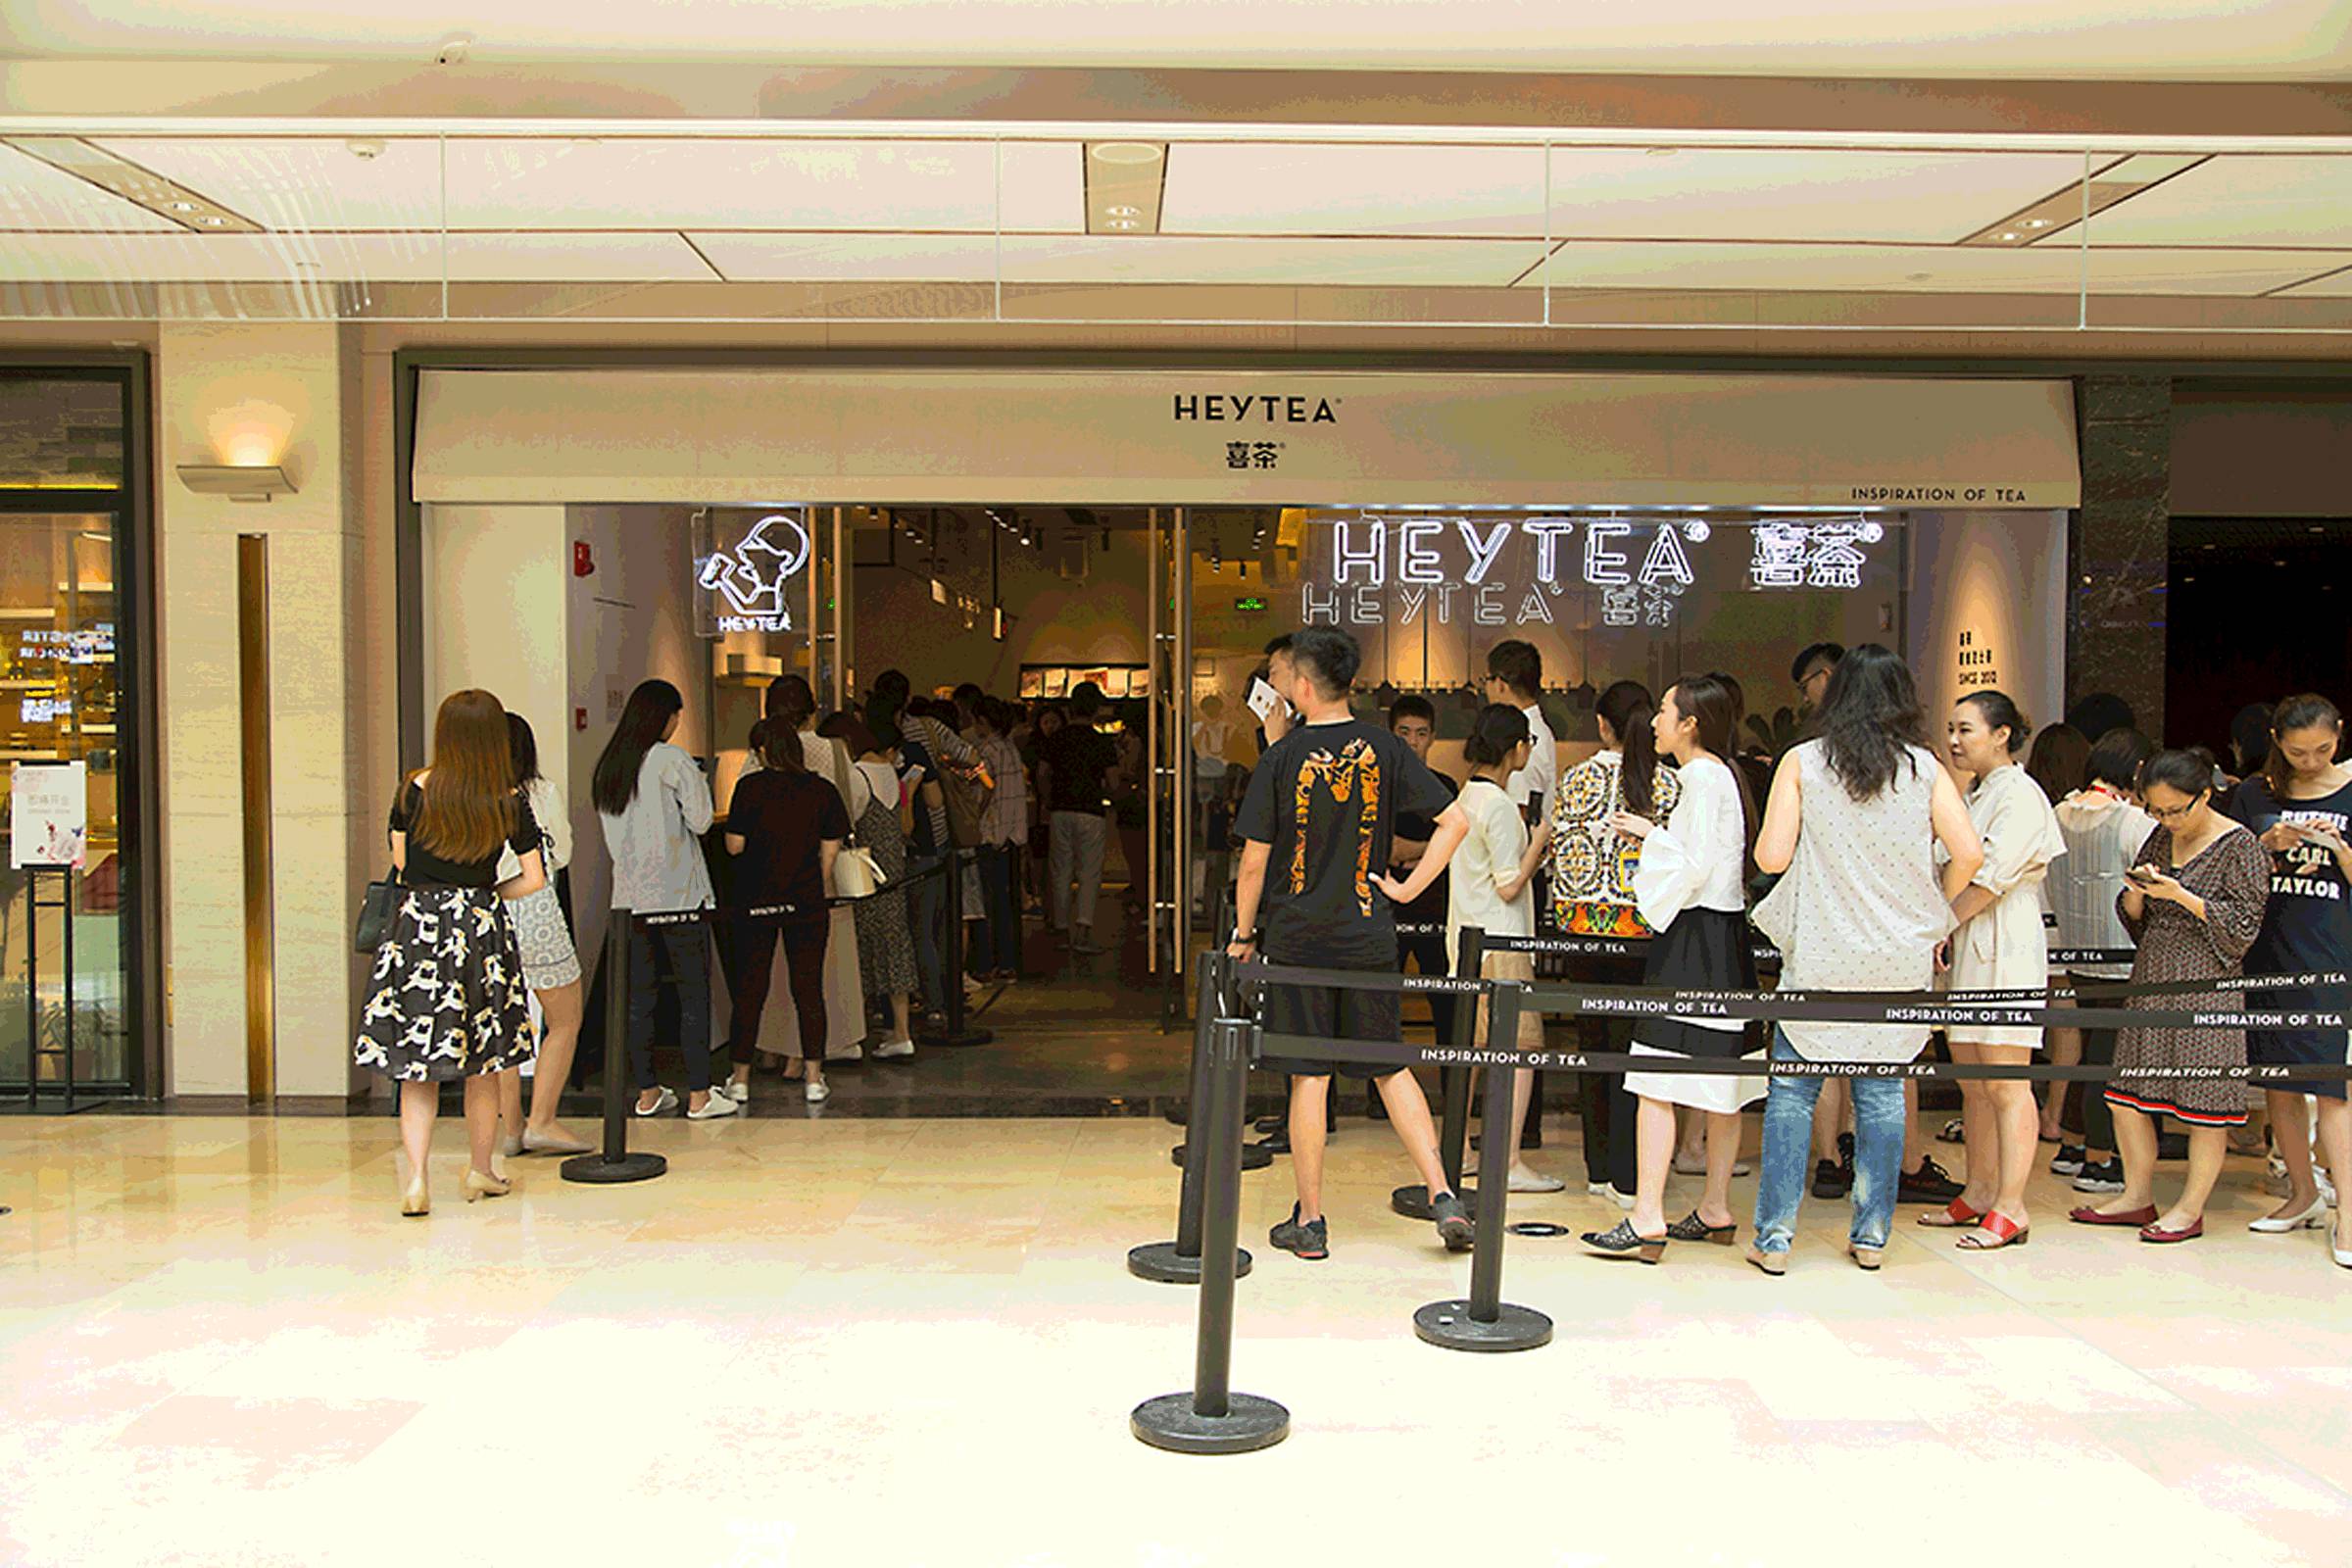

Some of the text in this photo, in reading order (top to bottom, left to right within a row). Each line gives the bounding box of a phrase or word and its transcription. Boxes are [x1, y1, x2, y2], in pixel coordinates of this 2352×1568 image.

[1174, 395, 1337, 423] HEYTEA
[1226, 441, 1278, 469] 喜茶
[1851, 487, 2026, 502] INSPIRATION OF TEA
[1334, 520, 1694, 585] HEYTEA
[1750, 522, 1867, 588] 喜茶
[718, 612, 792, 632] HEYTEA
[2286, 847, 2331, 865] CARL
[2272, 876, 2340, 900] TAYLOR
[1510, 941, 1627, 954] INSPIRATION OF TEA
[1403, 978, 1482, 991] INSPIRATION
[2216, 973, 2347, 990] INSPIRATION OF TEA
[1675, 991, 1753, 1001] INSPIRATION
[1783, 994, 1806, 1003] TEA
[1946, 991, 2026, 1001] INSPIRATION
[2054, 989, 2077, 998] TEA
[1582, 1000, 1729, 1015] INSPIRATION OF TEA
[1886, 1008, 2034, 1022] INSPIRATION OF TEA
[2193, 1014, 2343, 1026] INSPIRATION OF TEA
[1421, 1049, 1588, 1066] INSPIRATION OF TEA
[1769, 1063, 1936, 1075] INSPIRATION OF TEA
[2120, 1067, 2290, 1077] INSPIRATION OF TEA
